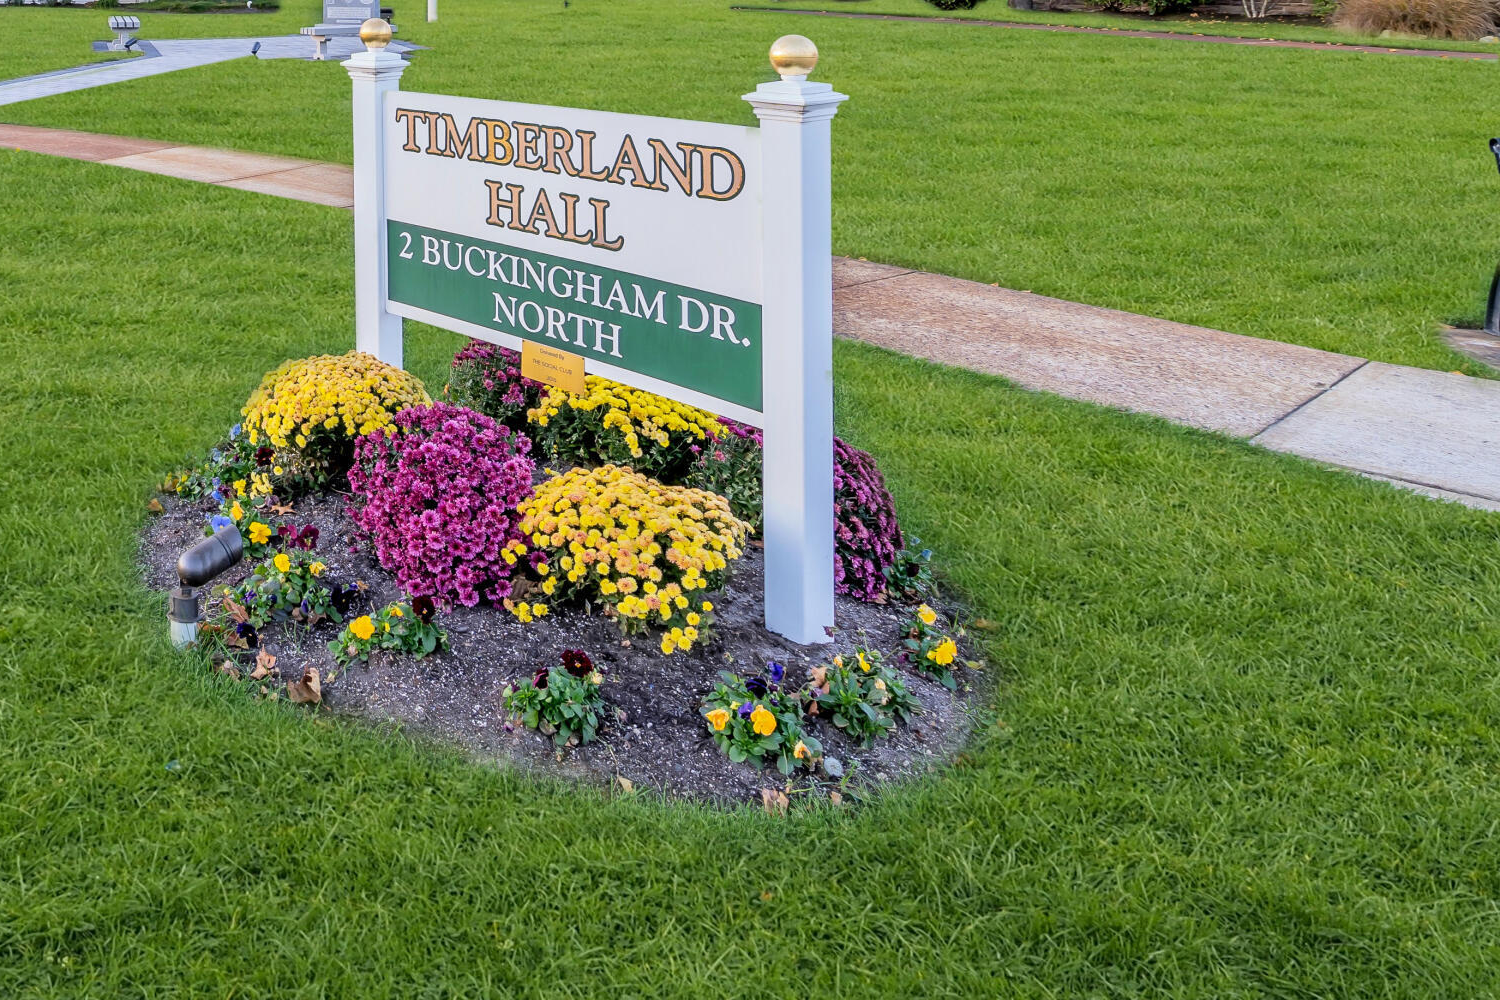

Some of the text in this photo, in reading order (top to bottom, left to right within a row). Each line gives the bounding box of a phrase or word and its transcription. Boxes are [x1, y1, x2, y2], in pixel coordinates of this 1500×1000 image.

[395, 108, 746, 202] TIMBERLAND
[484, 179, 624, 252] HALL
[398, 231, 752, 348] 2 BUCKINGHAM DR.
[492, 292, 623, 359] NORTH
[541, 361, 558, 371] SOCIAL
